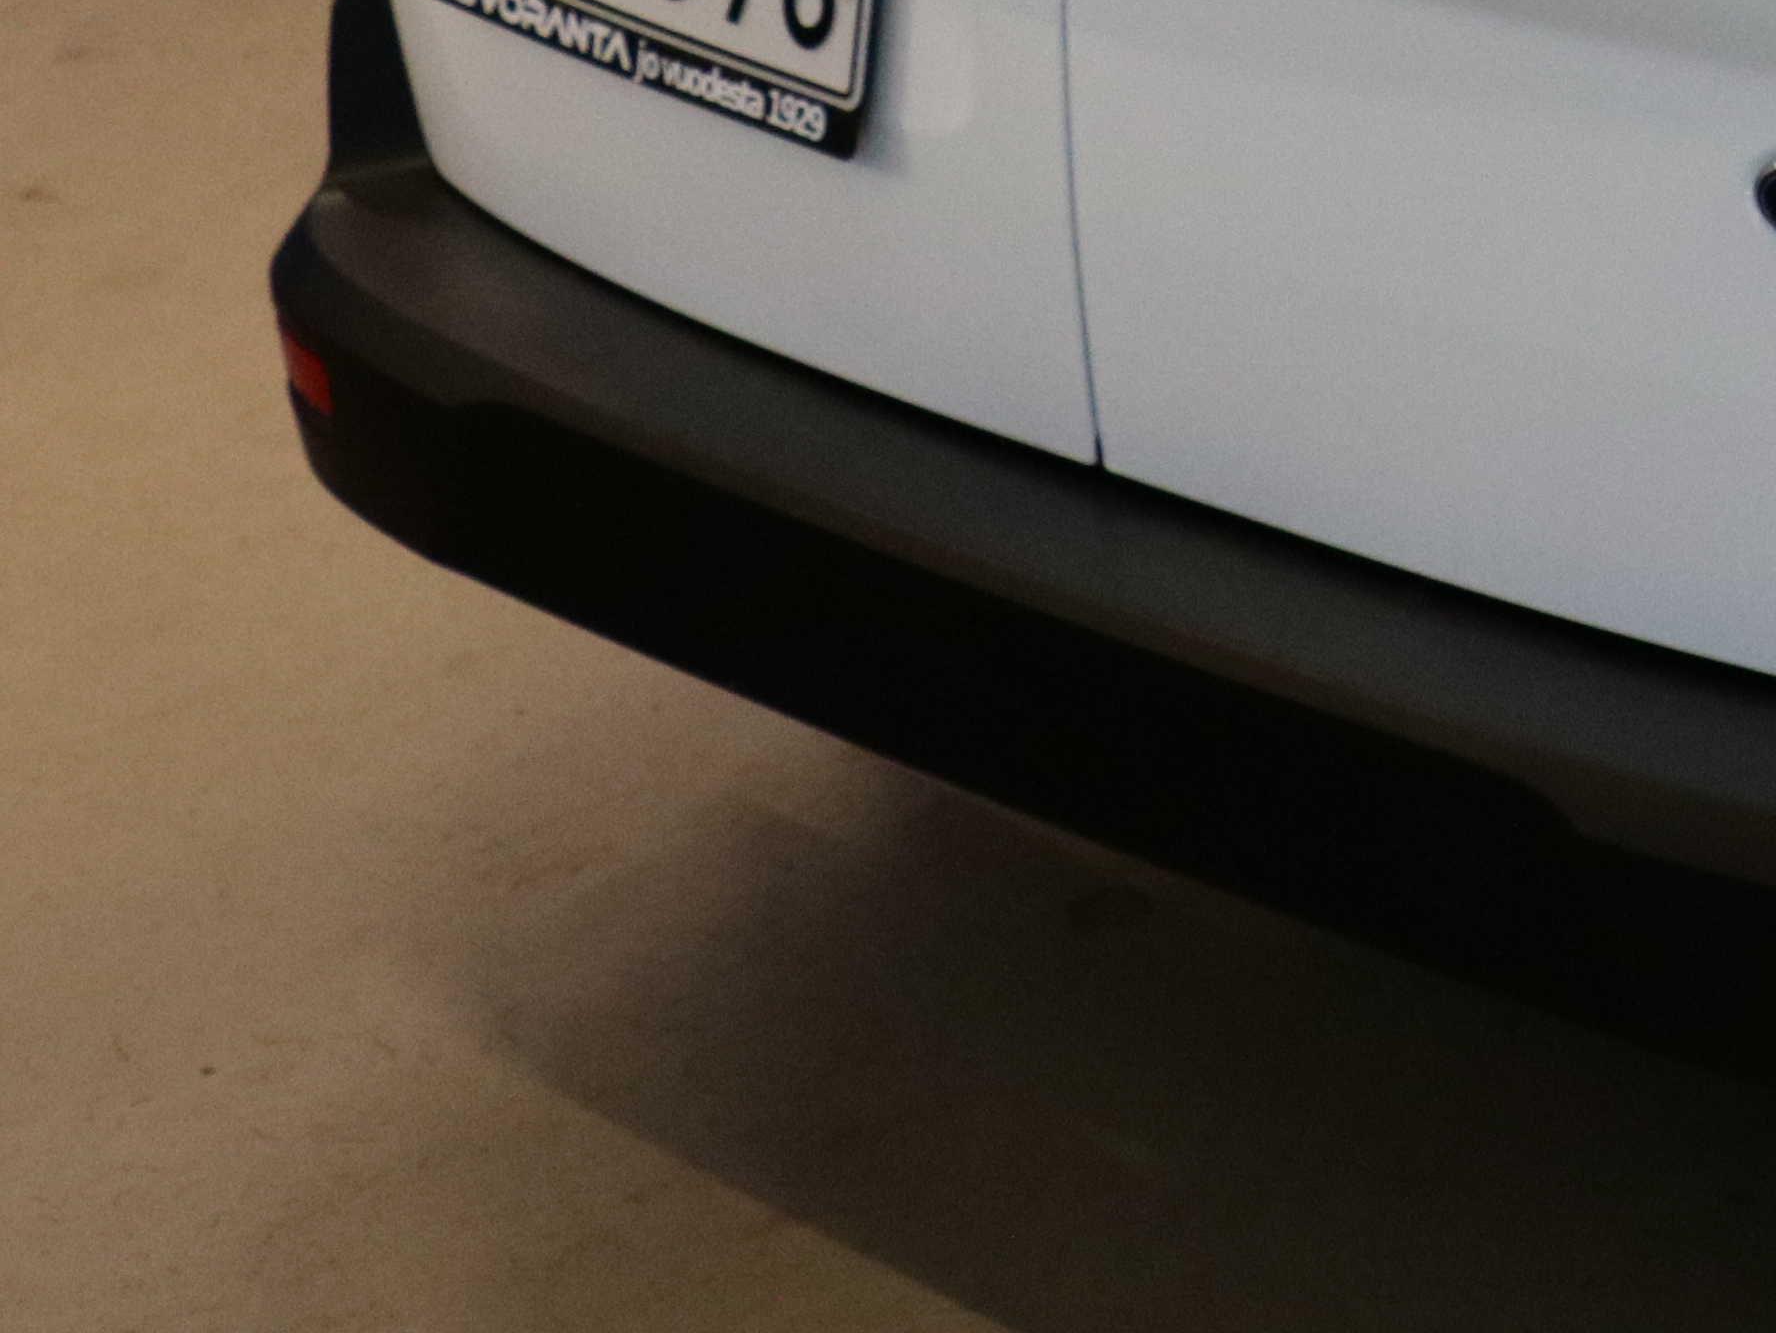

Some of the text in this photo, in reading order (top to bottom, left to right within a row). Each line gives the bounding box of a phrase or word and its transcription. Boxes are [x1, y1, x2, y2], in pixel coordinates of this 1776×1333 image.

[636, 39, 661, 82] jo
[661, 54, 765, 120] vuodesta
[766, 88, 828, 142] 1929
